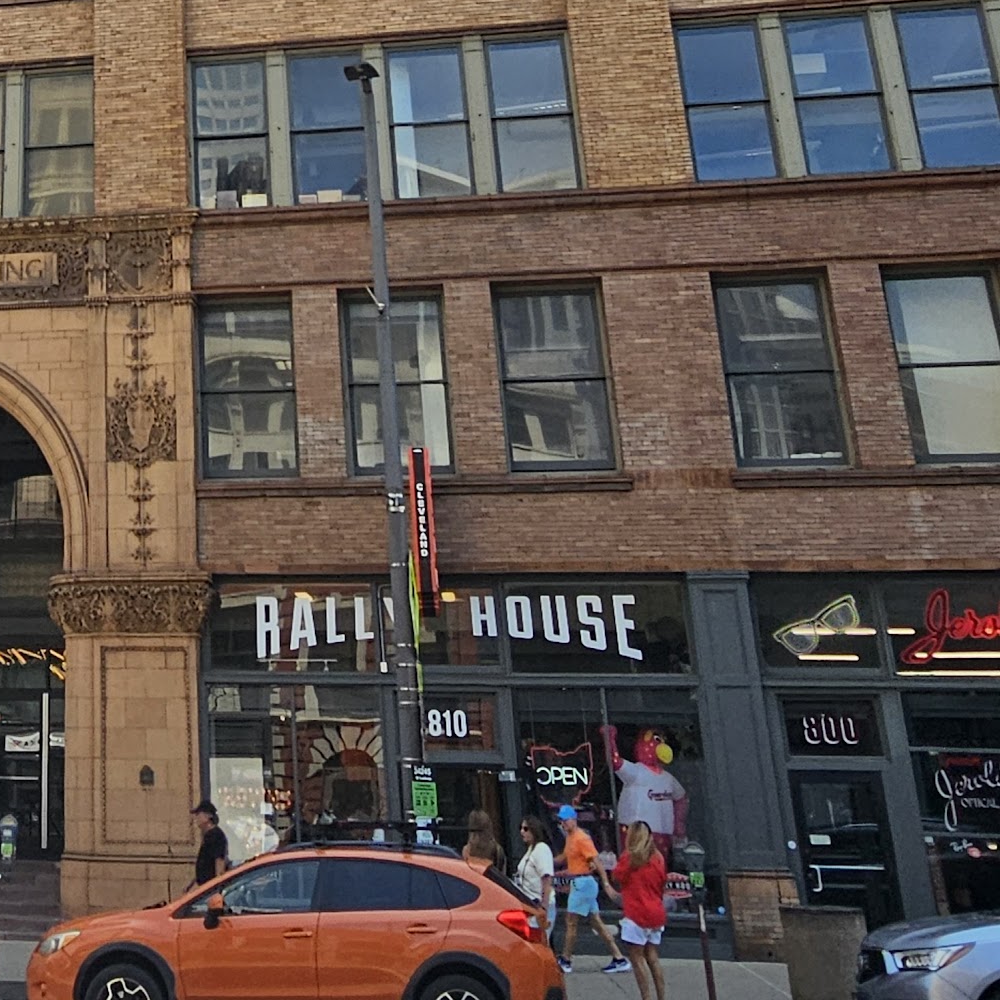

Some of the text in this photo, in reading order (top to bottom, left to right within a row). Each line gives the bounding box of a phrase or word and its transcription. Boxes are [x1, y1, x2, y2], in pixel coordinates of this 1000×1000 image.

[415, 483, 429, 557] CLEVELAND
[256, 595, 643, 661] RALL HOUSE
[428, 709, 467, 738] 810
[803, 714, 859, 745] 800
[536, 766, 588, 786] OPEN
